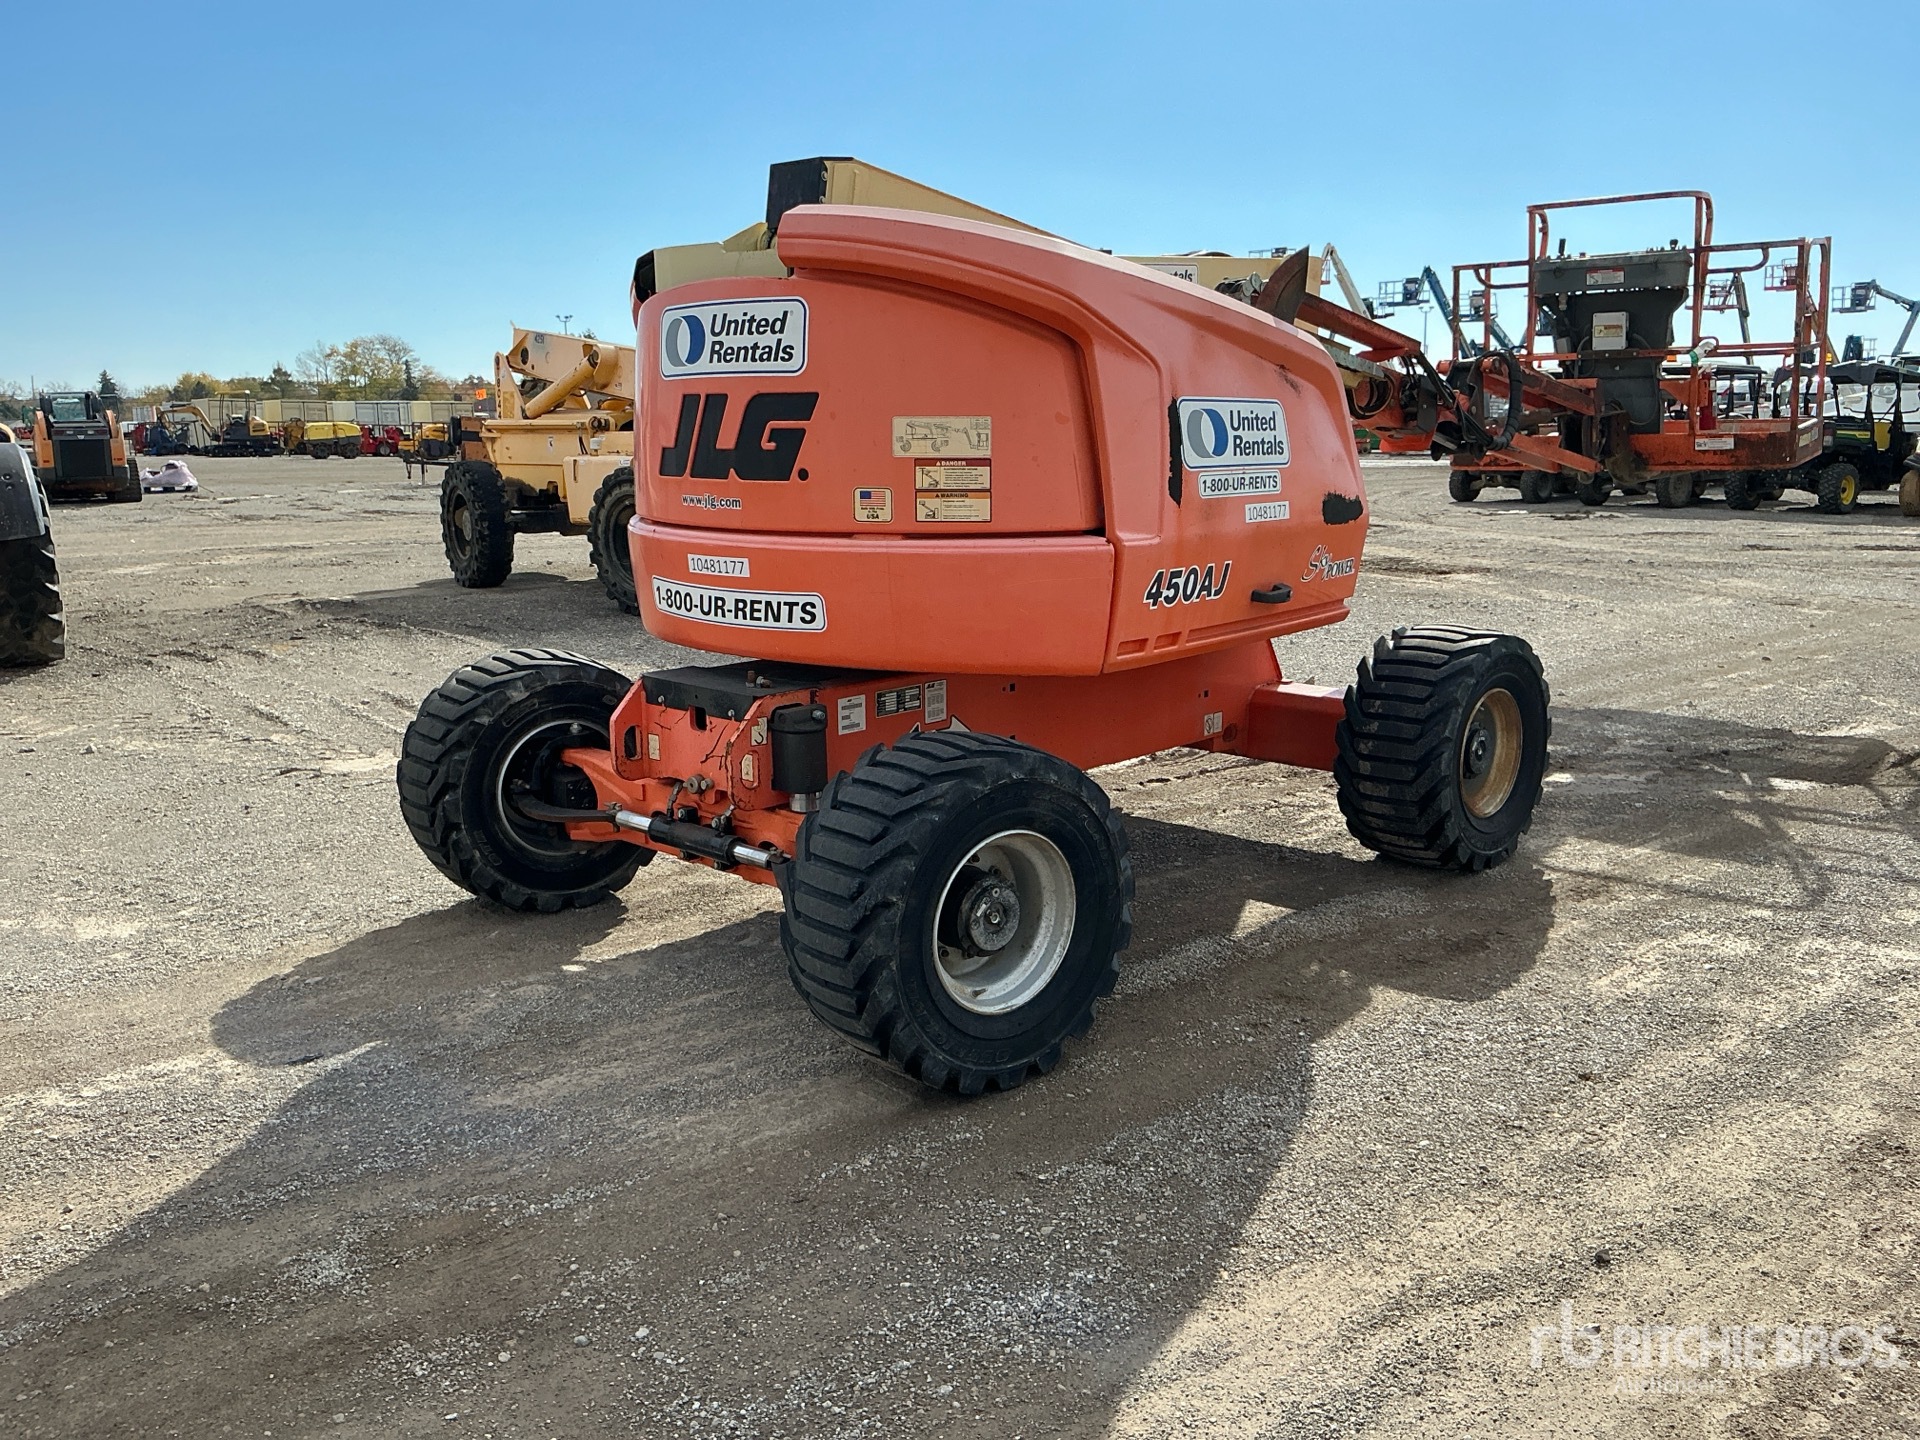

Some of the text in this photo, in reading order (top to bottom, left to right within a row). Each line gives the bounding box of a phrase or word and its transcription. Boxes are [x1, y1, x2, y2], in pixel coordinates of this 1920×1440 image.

[710, 310, 789, 337] United
[709, 338, 795, 364] Rentals
[1229, 410, 1277, 432] United
[1233, 435, 1285, 457] Rentals
[1202, 475, 1278, 493] 1-800-UR-RENTS
[682, 494, 742, 510] www.jlg.com
[1248, 504, 1287, 521] 10481177
[690, 557, 745, 575] 10481177
[1144, 561, 1233, 609] 450AJ
[655, 586, 817, 625] 1-800-UR-RENTS
